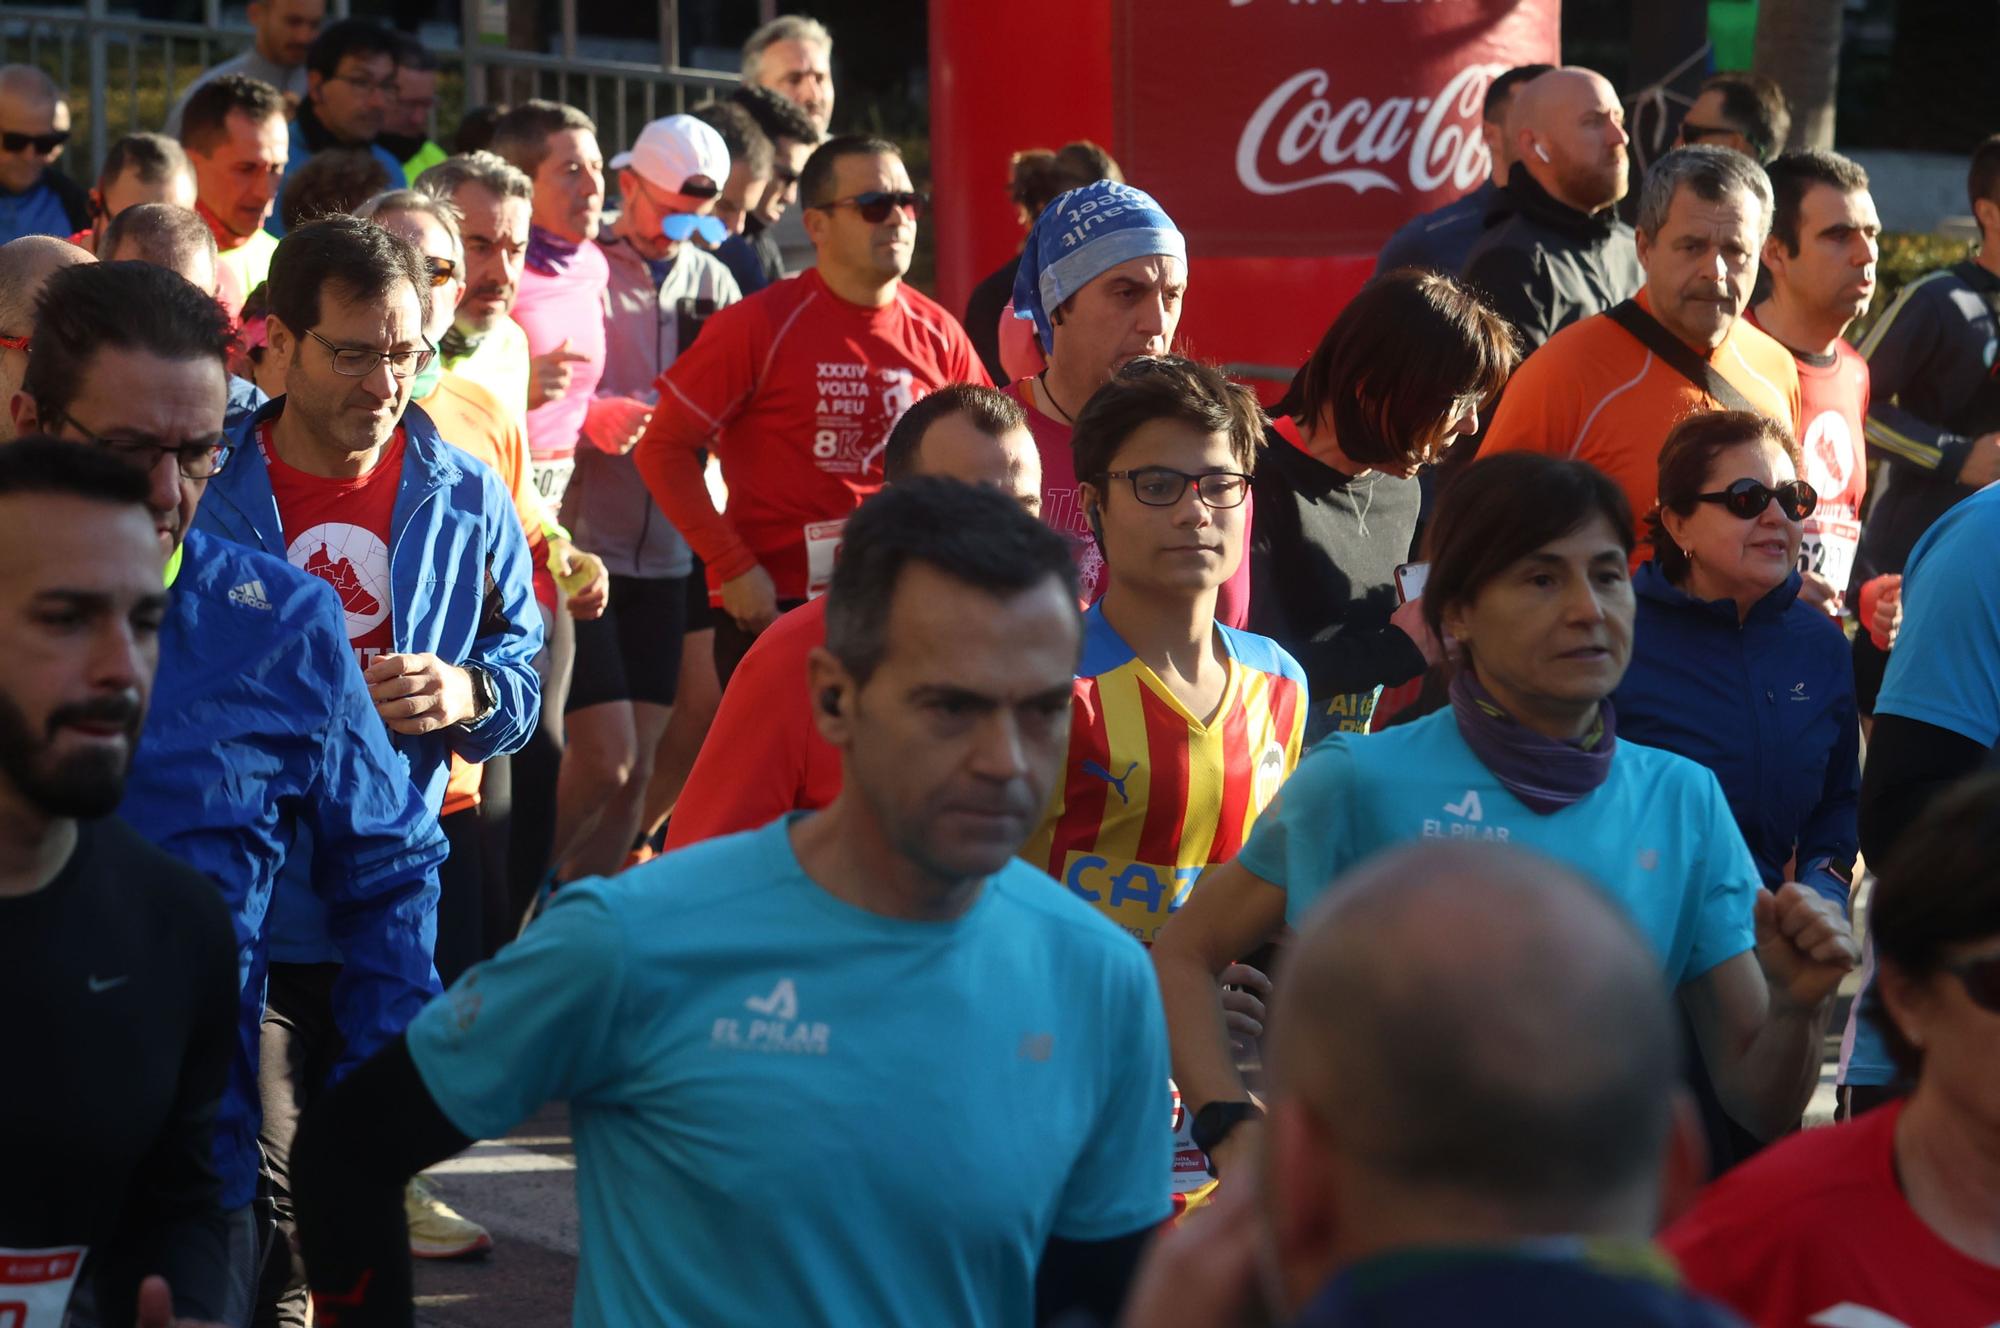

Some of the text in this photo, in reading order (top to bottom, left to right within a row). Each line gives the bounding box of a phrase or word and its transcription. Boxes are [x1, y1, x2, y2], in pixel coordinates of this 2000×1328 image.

[816, 362, 868, 379] XXXIV
[816, 381, 869, 397] VOLTA
[815, 399, 865, 415] A PEU
[813, 430, 863, 460] 8K
[228, 589, 272, 610] adidas
[1423, 819, 1510, 843] EL PILAR
[711, 1017, 831, 1046] EL PILAR
